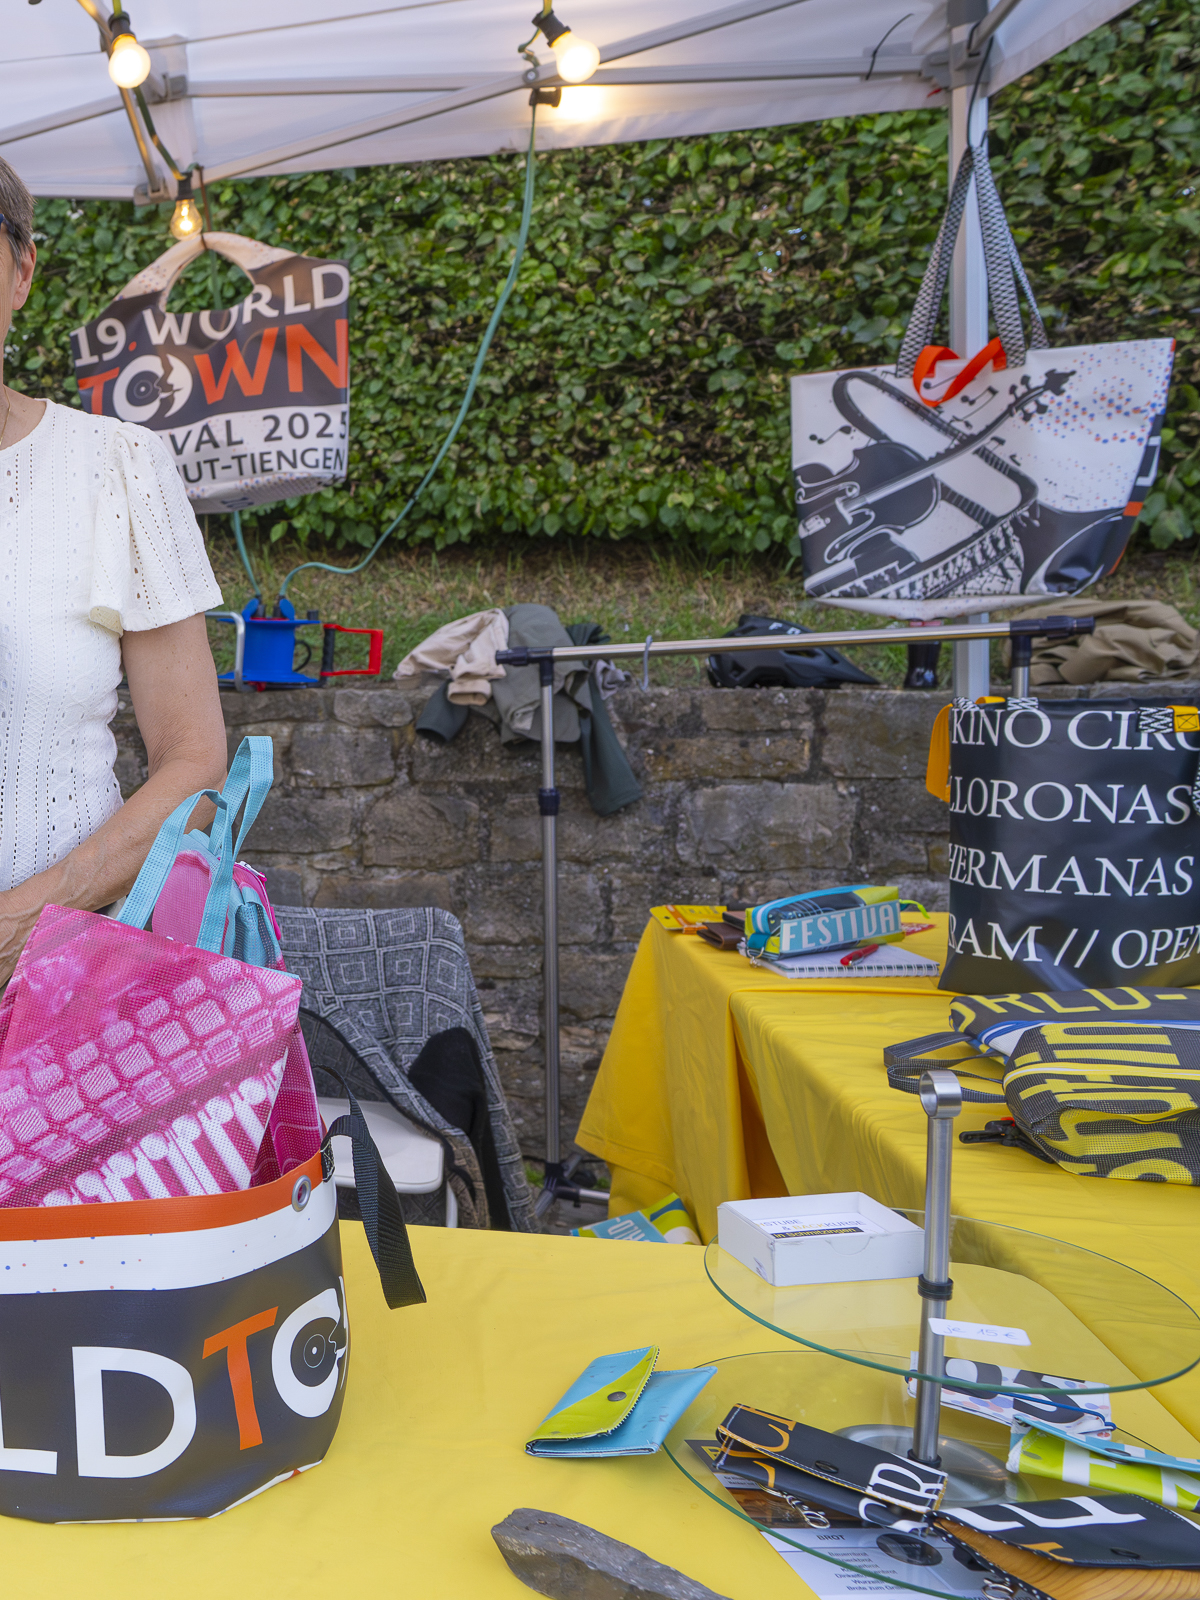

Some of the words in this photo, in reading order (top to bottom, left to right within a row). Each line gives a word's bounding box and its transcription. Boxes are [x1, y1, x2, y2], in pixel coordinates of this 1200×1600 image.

[70, 317, 137, 367] 19.
[142, 264, 349, 346] WORLD
[77, 319, 349, 423] TOWN
[160, 419, 244, 456] VAL
[177, 448, 346, 484] UT-TIENGEN
[952, 708, 1052, 748] KINO
[782, 902, 900, 951] FESTIVA
